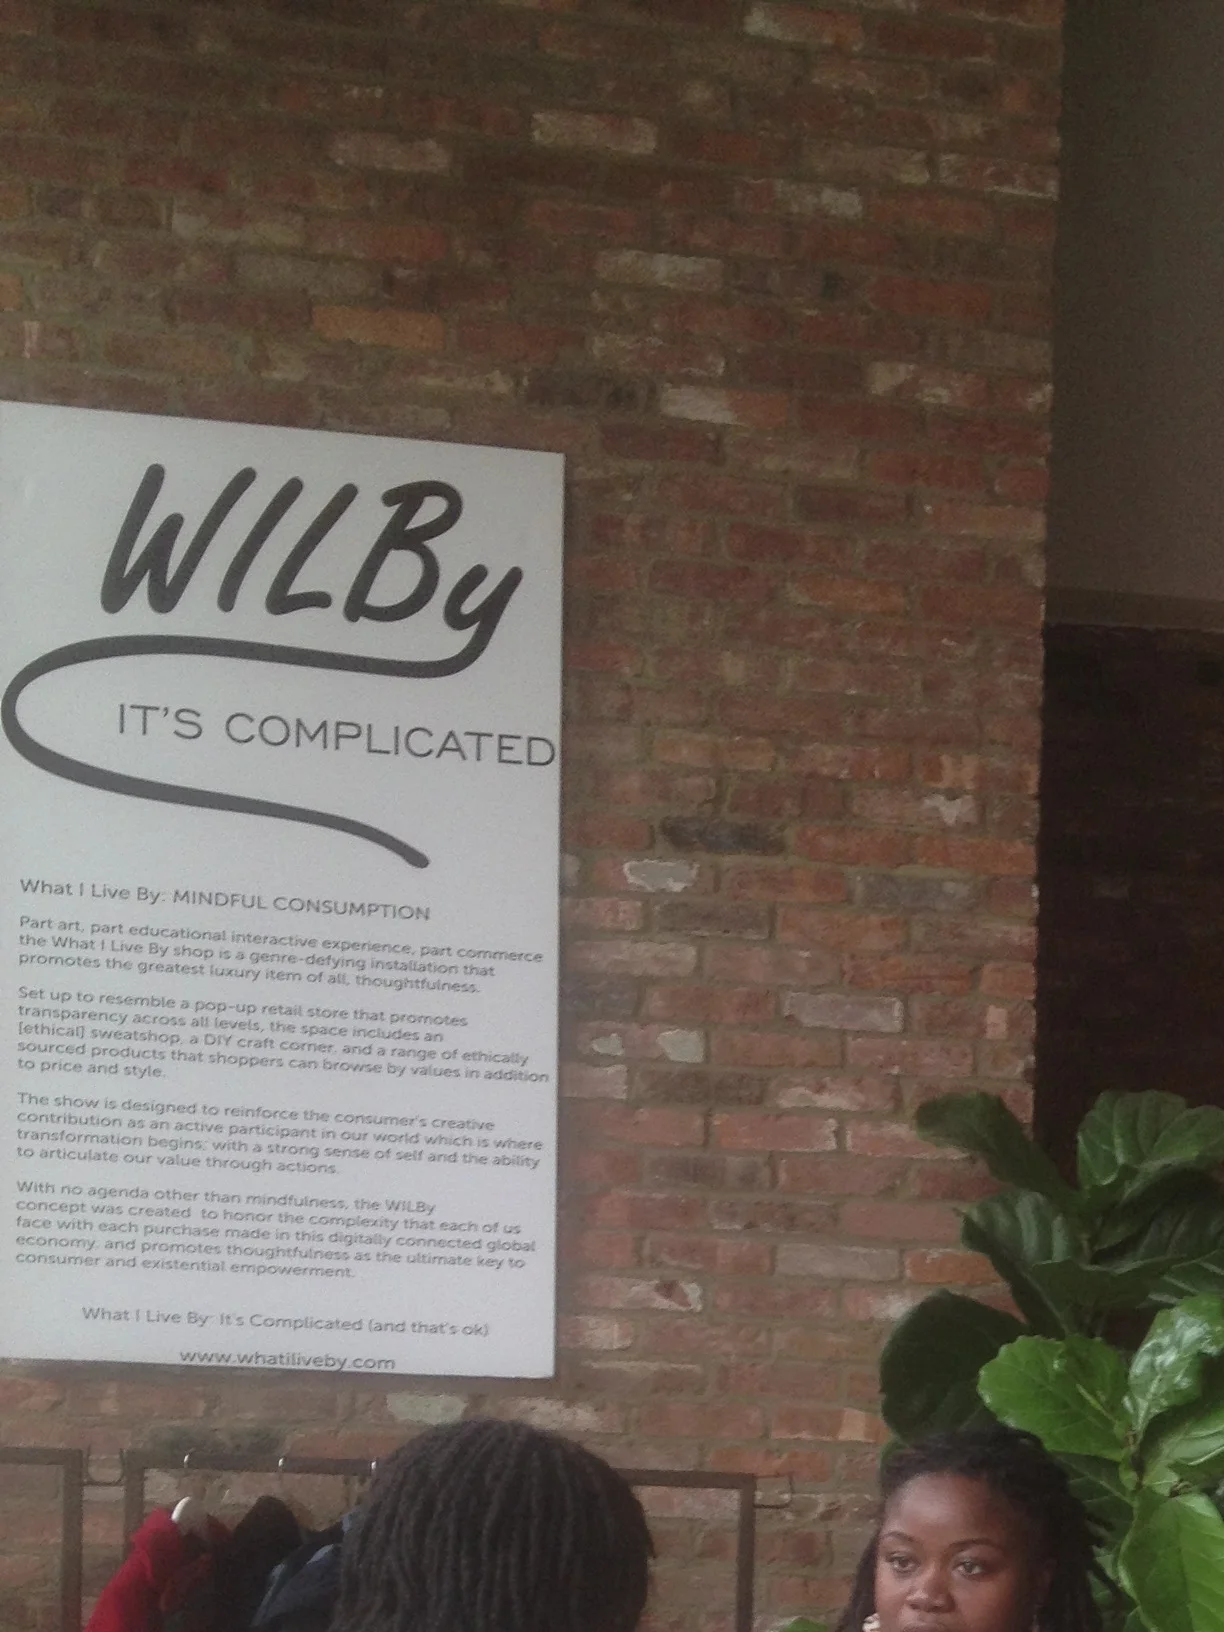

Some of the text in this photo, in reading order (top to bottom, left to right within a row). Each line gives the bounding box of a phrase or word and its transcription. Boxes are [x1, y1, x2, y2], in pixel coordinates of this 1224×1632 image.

[101, 463, 523, 668] WILBy
[118, 703, 556, 766] IT'S COMPLICATED
[20, 878, 73, 896] What
[91, 883, 130, 900] Live
[173, 889, 266, 909] MINDFUL
[272, 895, 430, 920] CONSUMPTION
[19, 915, 52, 930] Part
[90, 922, 123, 936] part
[128, 923, 226, 941] educational
[231, 929, 317, 948] interactive
[420, 944, 452, 958] part
[456, 947, 543, 963] commerce
[19, 933, 46, 947] the
[51, 935, 95, 951] What
[110, 939, 143, 954] Live
[148, 942, 168, 958] By
[173, 944, 214, 961] shop
[218, 946, 231, 959] is
[249, 951, 366, 971] genre-defying
[370, 956, 458, 974] installation
[463, 962, 495, 977] that
[18, 953, 100, 968] promotes
[105, 956, 133, 970] the
[137, 961, 204, 975] greatest
[209, 963, 261, 982] luxury
[265, 966, 302, 981] item
[306, 970, 323, 983] of
[18, 986, 45, 1000] Set
[50, 990, 72, 1005] up
[76, 989, 94, 1003] to
[98, 993, 175, 1008] resemble
[194, 999, 257, 1016] pop-up
[261, 1002, 302, 1016] retail
[307, 1004, 348, 1019] store
[353, 1007, 384, 1021] that
[390, 1012, 468, 1026] promotes
[18, 1004, 128, 1026] transparency
[132, 1014, 186, 1027] across
[190, 1015, 208, 1028] all
[270, 1020, 296, 1033] the
[301, 1024, 348, 1038] space
[352, 1025, 419, 1041] includes
[423, 1032, 444, 1042] an
[17, 1042, 549, 1083] sourced products that shoppers can browse by values in addition
[17, 1057, 35, 1070] to
[40, 1059, 82, 1074] price
[87, 1062, 118, 1075] and
[204, 1032, 232, 1046] DIY
[236, 1036, 274, 1049] craft
[342, 1042, 372, 1055] and
[390, 1046, 436, 1061] range
[440, 1047, 458, 1060] of
[461, 1048, 529, 1067] ethically
[17, 1091, 495, 1131] The show is designed to reinforce the consumer's creative
[16, 1112, 543, 1150] contribution as an active participant in our world which is where
[16, 1145, 35, 1158] to
[39, 1147, 118, 1162] articulate
[122, 1153, 152, 1164] our
[156, 1153, 201, 1167] value
[205, 1155, 272, 1173] through
[16, 1180, 55, 1195] With
[60, 1185, 83, 1196] no
[87, 1186, 149, 1200] agenda
[154, 1187, 198, 1202] other
[204, 1189, 241, 1204] than
[354, 1197, 380, 1210] the
[385, 1198, 436, 1216] WILBy
[16, 1215, 536, 1253] face with each purchase made in this digitally connected global
[15, 1253, 100, 1267] consumer
[105, 1255, 137, 1268] and
[141, 1257, 225, 1272] existential
[82, 1306, 129, 1321] What
[146, 1309, 181, 1323] Live
[220, 1312, 244, 1326] It's
[249, 1313, 363, 1331] Complicated
[368, 1317, 406, 1334] (and
[410, 1319, 457, 1334] that's
[461, 1321, 489, 1338] ok)
[180, 1350, 395, 1370] www.whatiliveby.com
